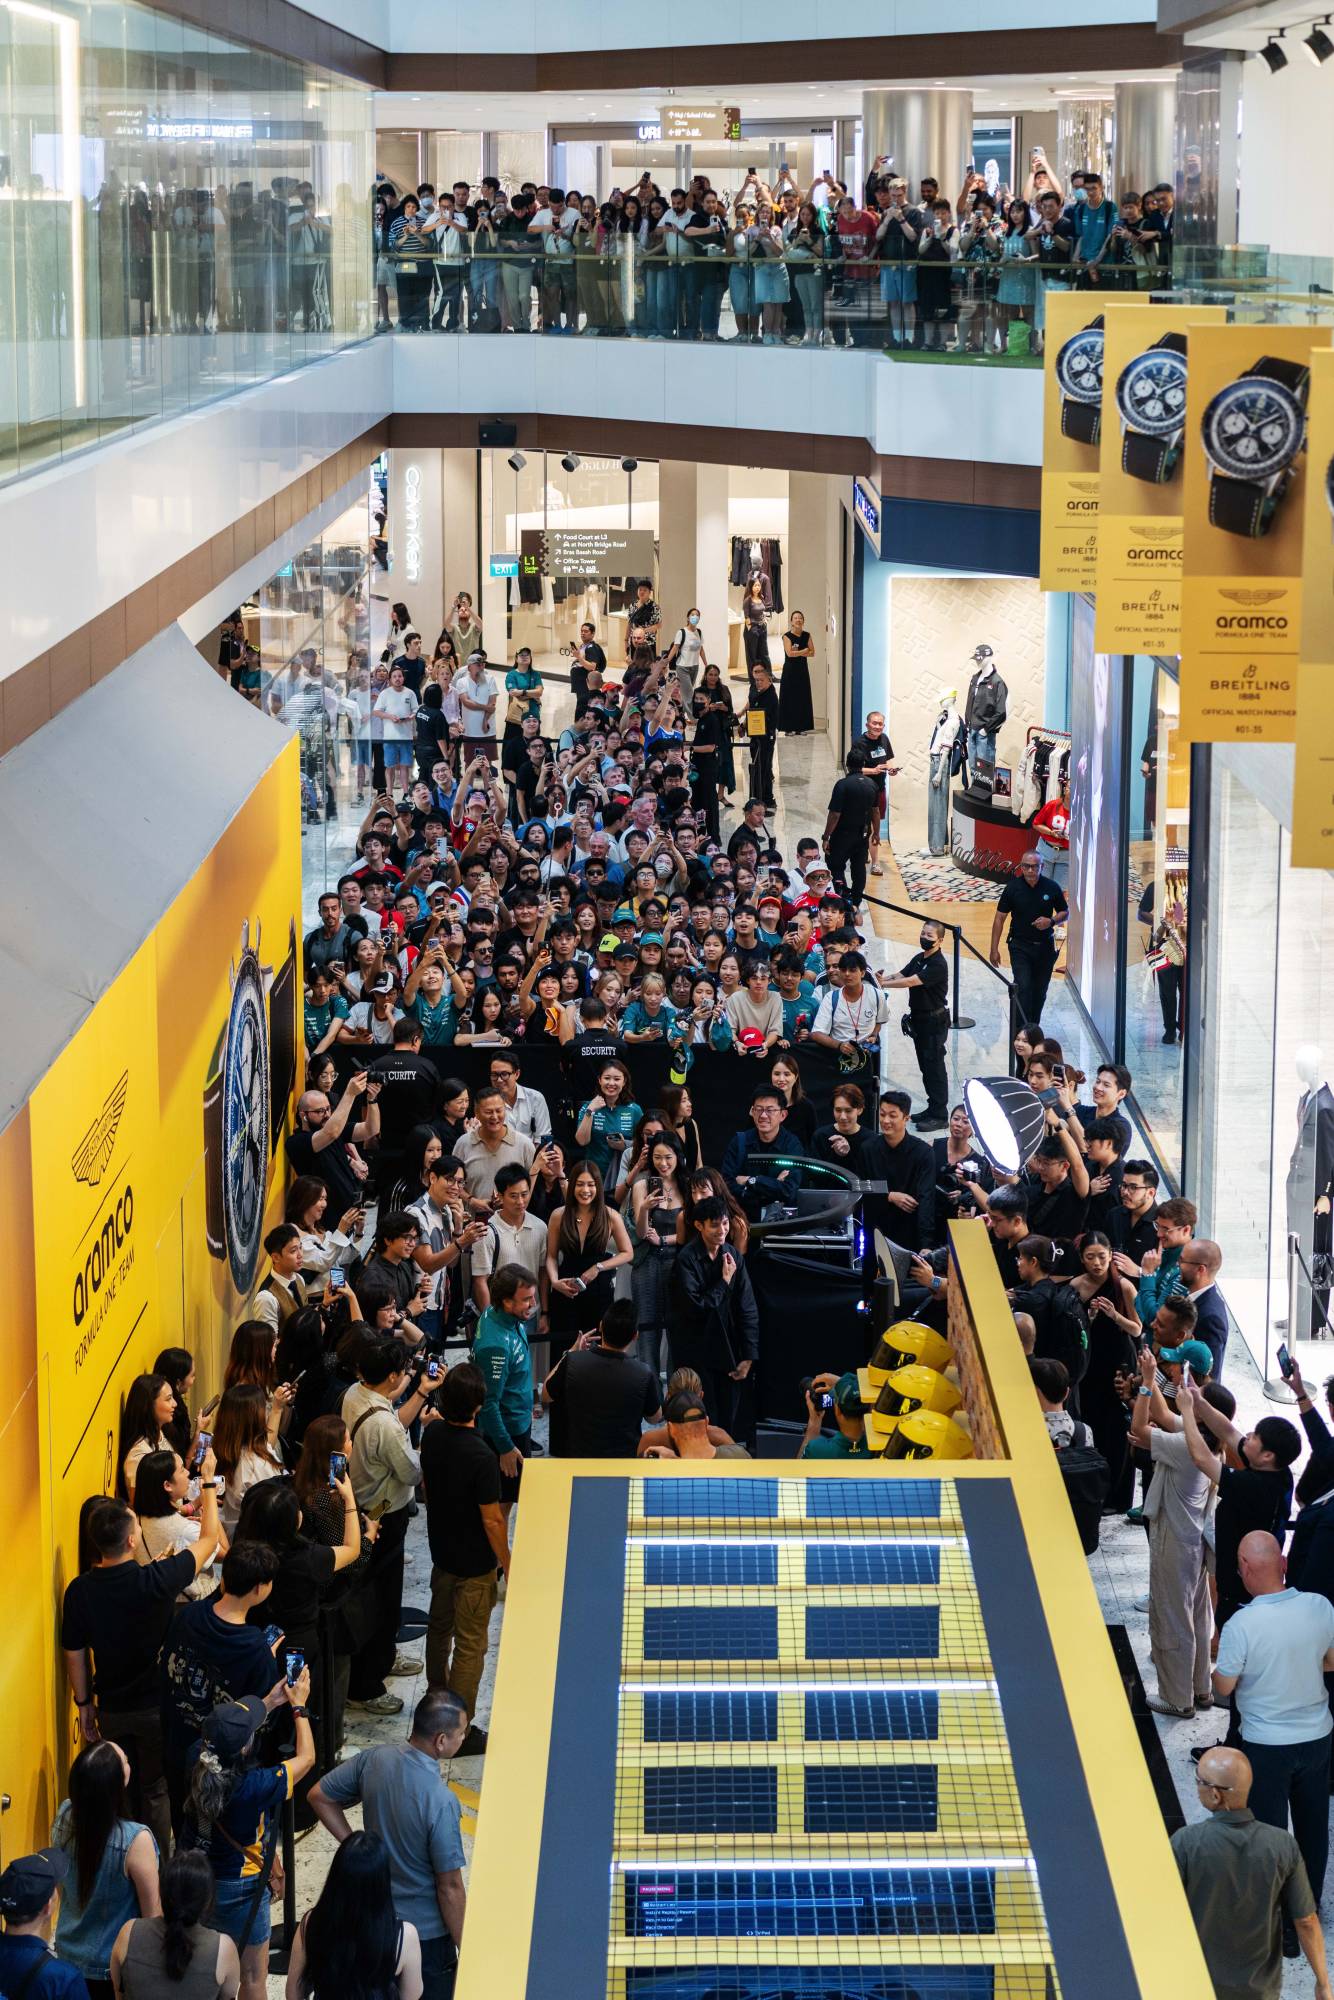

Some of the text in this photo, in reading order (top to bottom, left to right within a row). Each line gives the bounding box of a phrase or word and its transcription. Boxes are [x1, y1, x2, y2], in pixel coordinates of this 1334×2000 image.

[405, 465, 421, 580] Calvin Klein
[595, 541, 612, 549] Bridge
[612, 541, 627, 549] Road
[524, 556, 536, 566] L1
[494, 565, 513, 574] EXIT
[1121, 603, 1182, 612] BREITLIN
[1216, 616, 1288, 629] aramco
[1210, 680, 1291, 691] BREITLING
[1238, 693, 1261, 701] 1884
[1201, 708, 1234, 716] OFFICIAL
[1264, 709, 1297, 717] PARTNER
[581, 1046, 617, 1056] SECURITY
[388, 1070, 417, 1081] CURITY
[73, 1184, 134, 1327] aramco
[74, 1309, 104, 1375] FORMULA
[118, 1244, 135, 1286] TEAM
